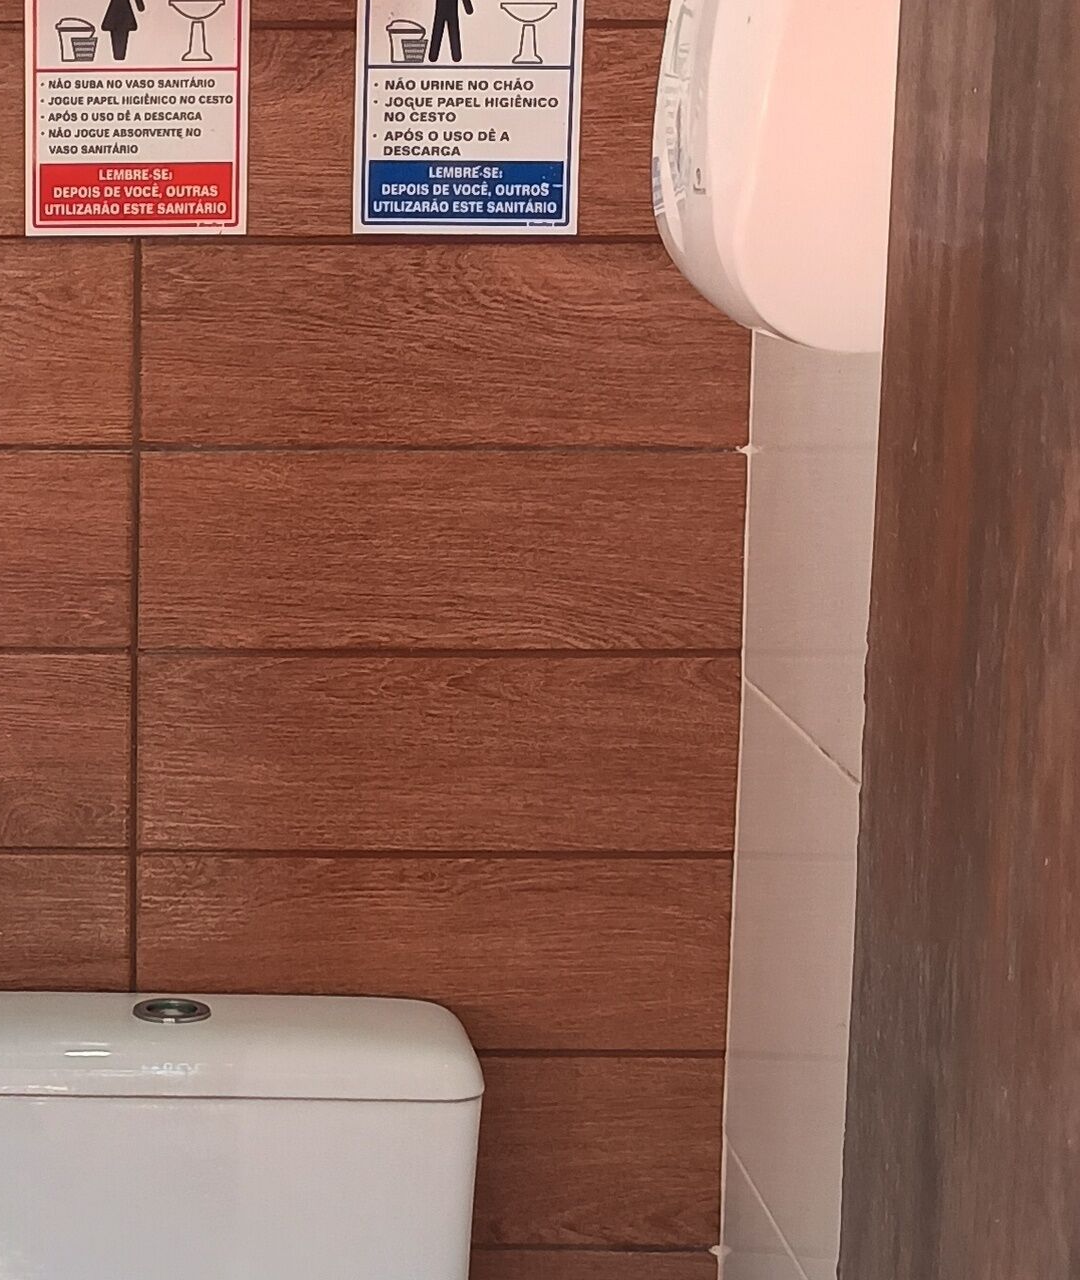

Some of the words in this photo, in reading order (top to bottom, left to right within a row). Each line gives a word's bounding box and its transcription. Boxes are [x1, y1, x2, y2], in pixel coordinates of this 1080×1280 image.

[48, 78, 71, 89] NÃO
[74, 80, 104, 89] SUBA
[106, 80, 122, 88] NO
[125, 80, 155, 88] VASO
[158, 77, 215, 88] SANITÁRIO
[385, 77, 416, 91] NÃO
[420, 81, 463, 91] URINE
[468, 81, 489, 91] NO
[493, 78, 534, 91] CHÃO
[48, 97, 83, 105] JOGUE
[87, 97, 119, 105] PAPEL
[122, 93, 176, 105] HIGIÊNICO
[179, 96, 196, 104] NO
[199, 96, 233, 104] CESTO
[385, 97, 433, 110] JOGUE
[437, 98, 481, 107] PAPEL
[485, 95, 559, 107] HIGIÊNICO
[48, 110, 78, 122] APÓS
[81, 113, 88, 121] O
[91, 113, 114, 121] USO
[117, 110, 131, 121] DÊ
[133, 112, 142, 121] A
[144, 112, 202, 121] DESCARGA
[384, 112, 405, 122] NO
[409, 112, 456, 122] CESTO
[48, 127, 71, 138] NÃO
[74, 129, 110, 138] JOGUE
[112, 128, 183, 138] ABSORVENTE
[185, 128, 201, 137] NO
[384, 129, 423, 141] APÓS
[428, 131, 438, 141] O
[443, 131, 474, 141] USO
[478, 129, 496, 141] DÊ
[500, 131, 510, 141] A
[49, 145, 78, 154] VASO
[81, 142, 138, 154] SANITÁRIO
[384, 146, 461, 156] DESCARGA
[99, 169, 172, 181] LEMBRE-SE:
[429, 167, 503, 179] LEMBRE-SE:
[53, 186, 100, 198] DEPOIS
[104, 186, 120, 198] DE
[124, 183, 162, 199] VOCÊ,
[166, 185, 218, 197] OUTRAS
[382, 184, 429, 196] DEPOIS
[433, 184, 449, 196] DE
[452, 181, 491, 197] VOCÊ,
[495, 183, 549, 196] OUTROS
[45, 201, 119, 215] UTILIZARÃO
[123, 203, 153, 214] ESTE
[157, 200, 227, 214] SANITÁRIO
[373, 198, 449, 213] UTILIZARÃO
[453, 201, 483, 212] ESTE
[487, 199, 557, 213] SANITÁRIO
